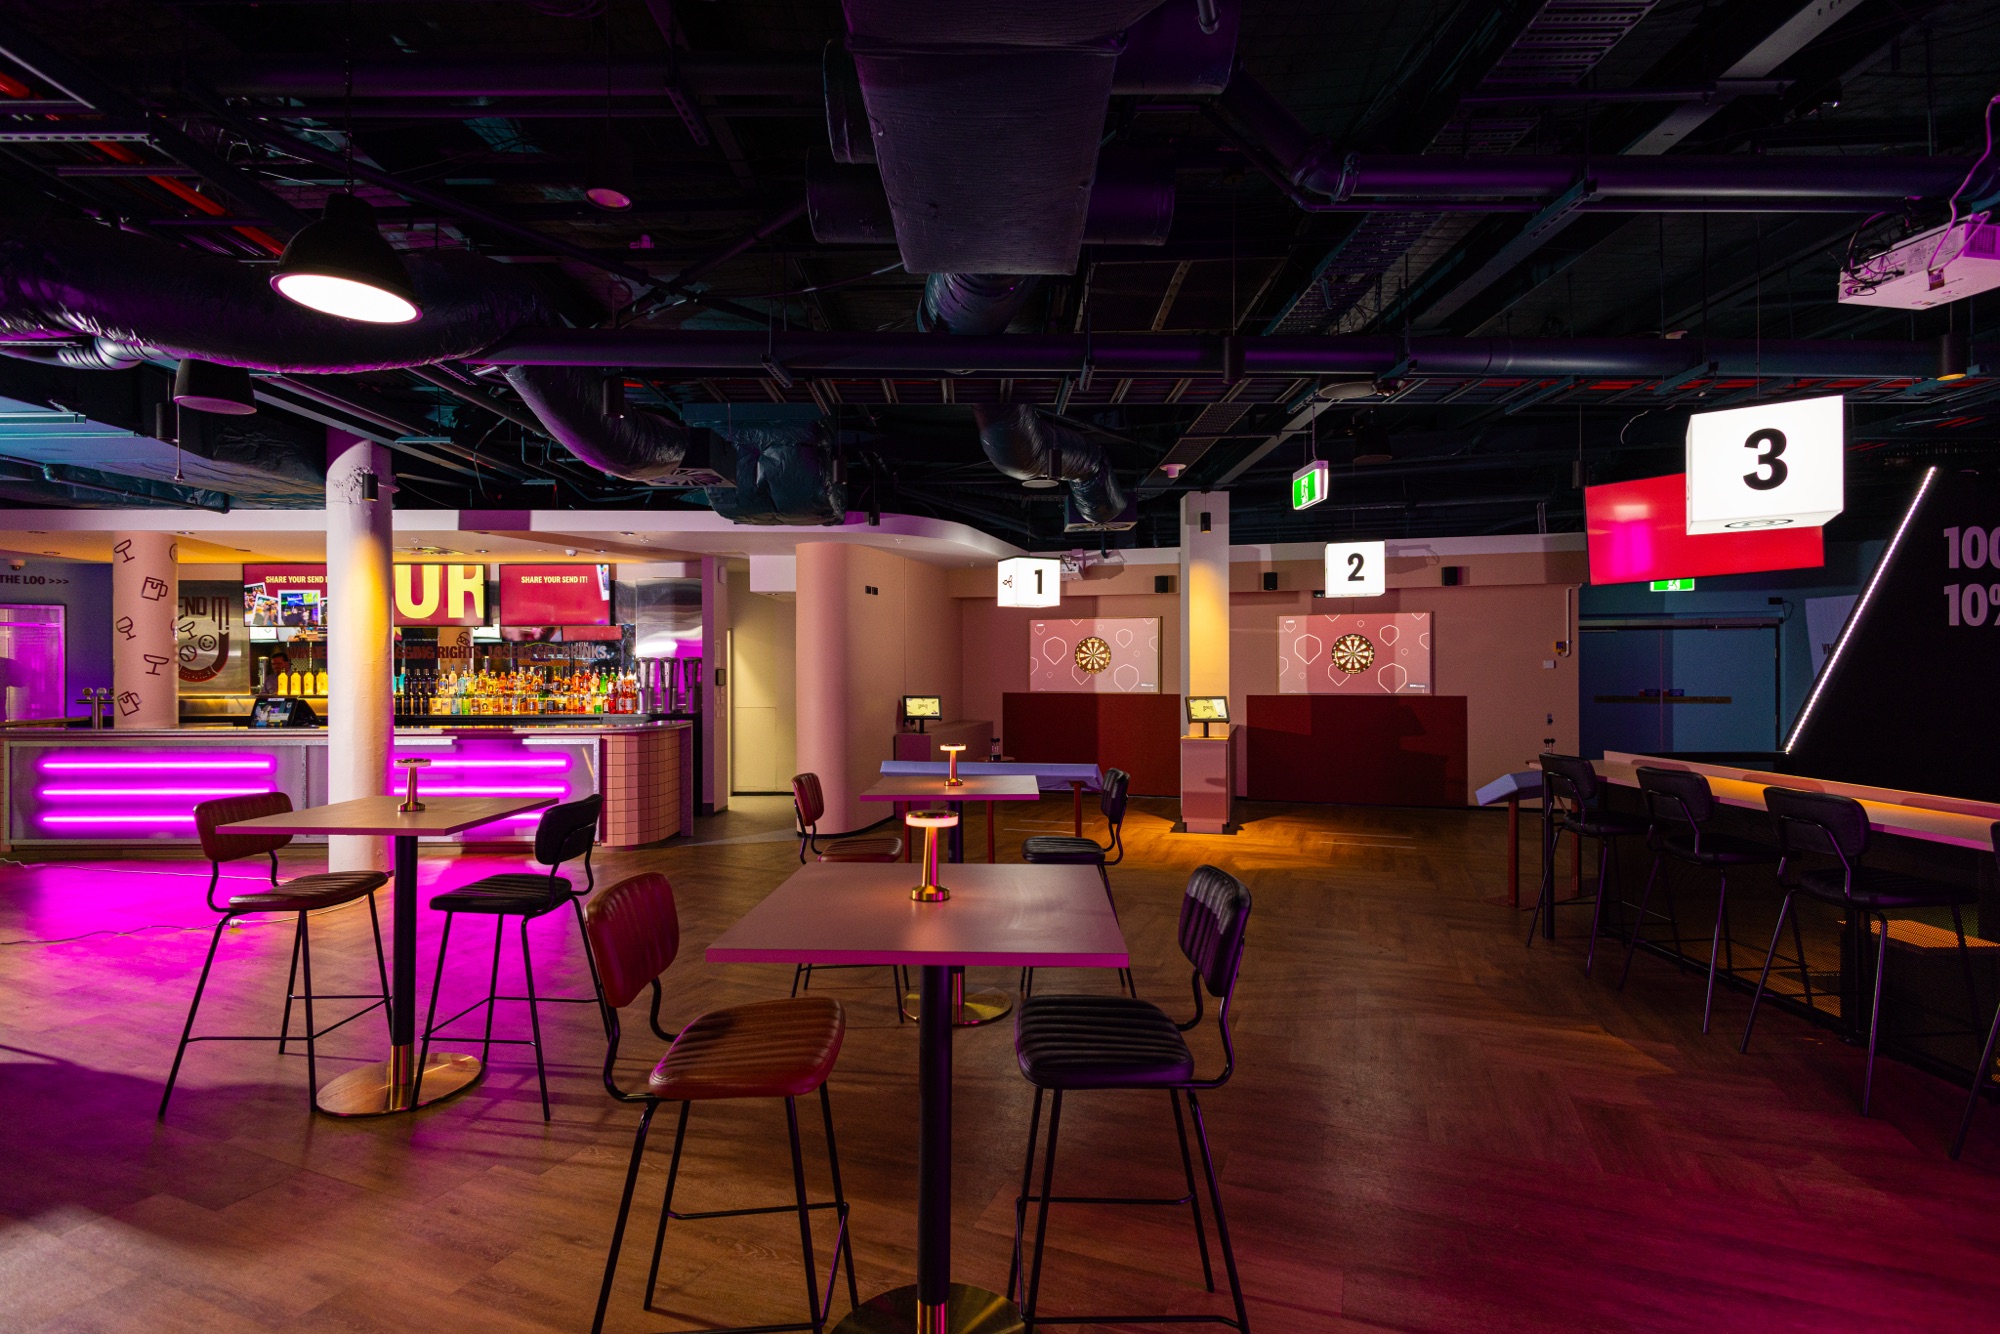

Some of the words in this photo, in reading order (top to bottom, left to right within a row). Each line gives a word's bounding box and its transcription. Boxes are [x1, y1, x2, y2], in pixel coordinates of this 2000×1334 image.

[1743, 428, 1788, 490] 3
[1347, 553, 1365, 581] 2
[0, 575, 20, 584] THE
[23, 576, 45, 585] LOO
[265, 575, 287, 584] SHARE
[288, 575, 306, 584] YOUR
[307, 575, 325, 584] SEND
[521, 576, 542, 584] SHARE
[543, 576, 561, 584] YOUR
[562, 576, 578, 584] SEND
[579, 576, 588, 584] IT!
[1034, 569, 1043, 594] 1
